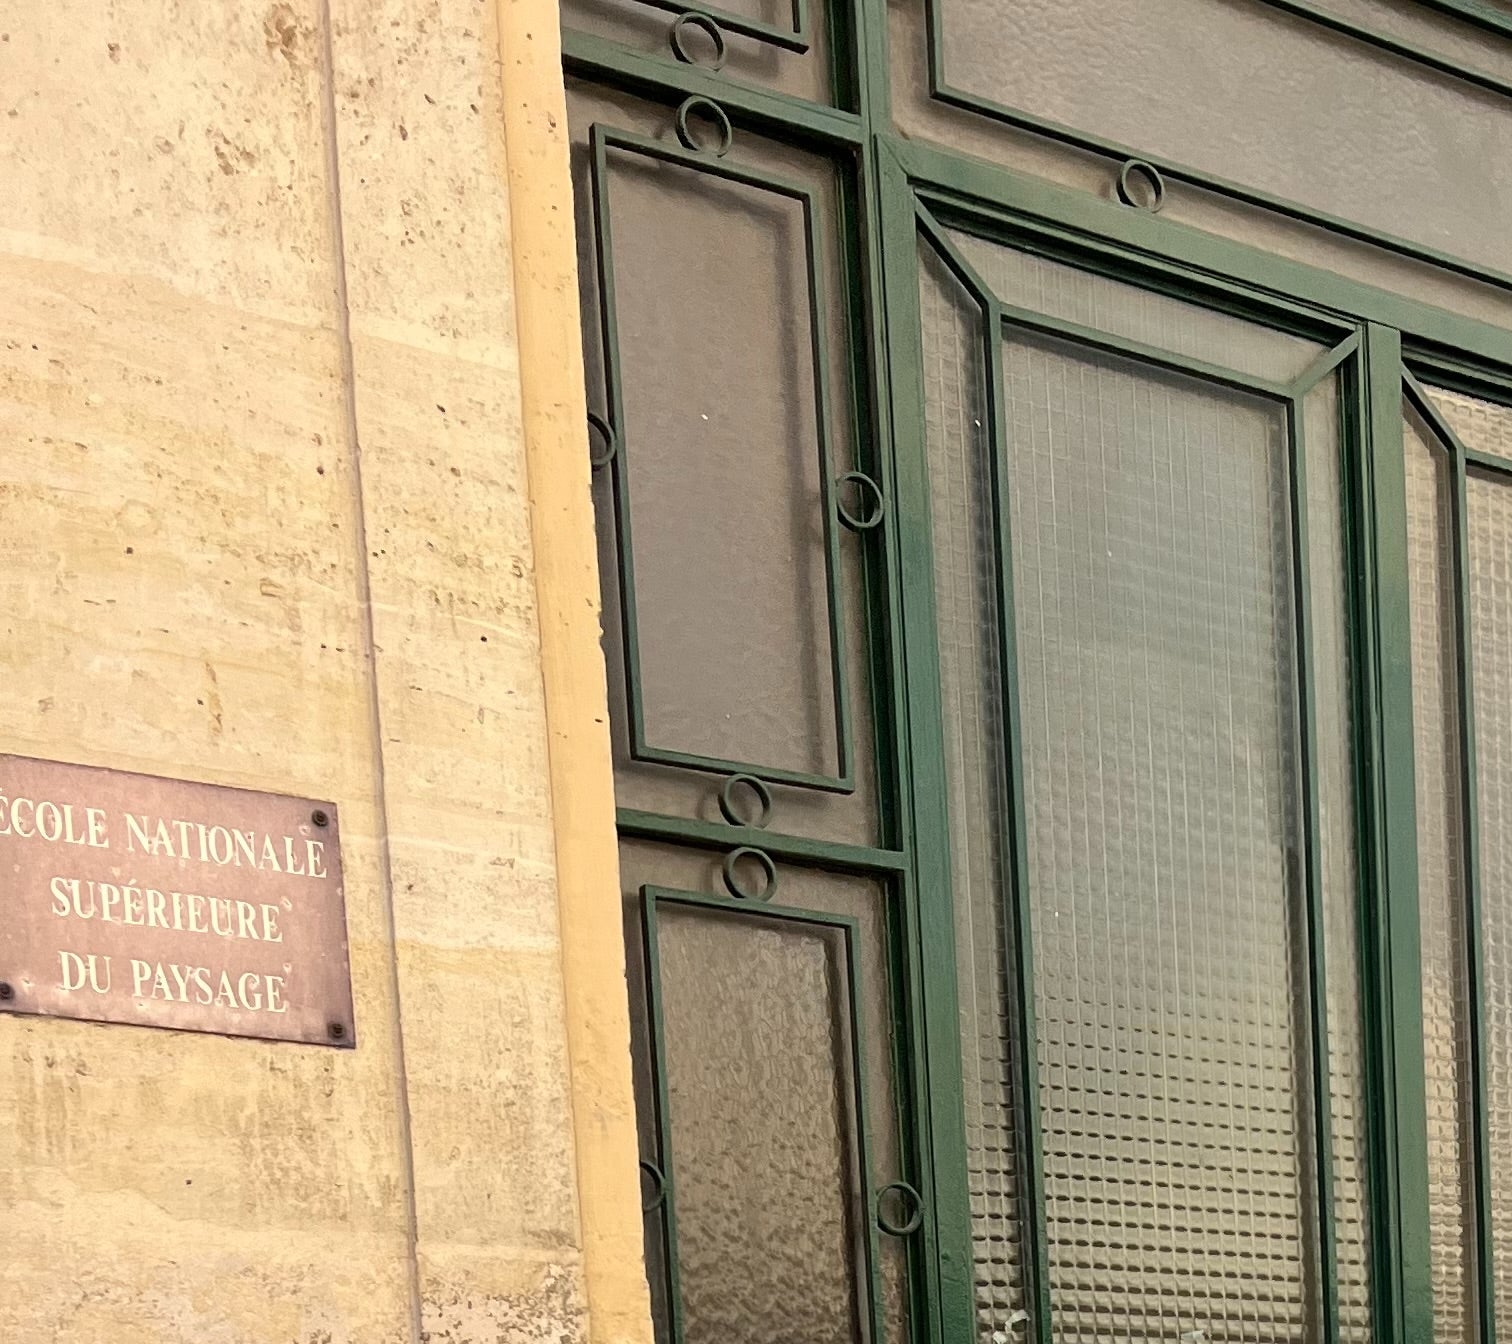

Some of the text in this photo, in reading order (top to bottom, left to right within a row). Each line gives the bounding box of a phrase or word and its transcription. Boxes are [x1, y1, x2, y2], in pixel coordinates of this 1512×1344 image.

[125, 813, 328, 879] NATIONALE
[50, 876, 283, 943] SUPÉRIEURE
[58, 951, 288, 1013] DU PAYSAGE
